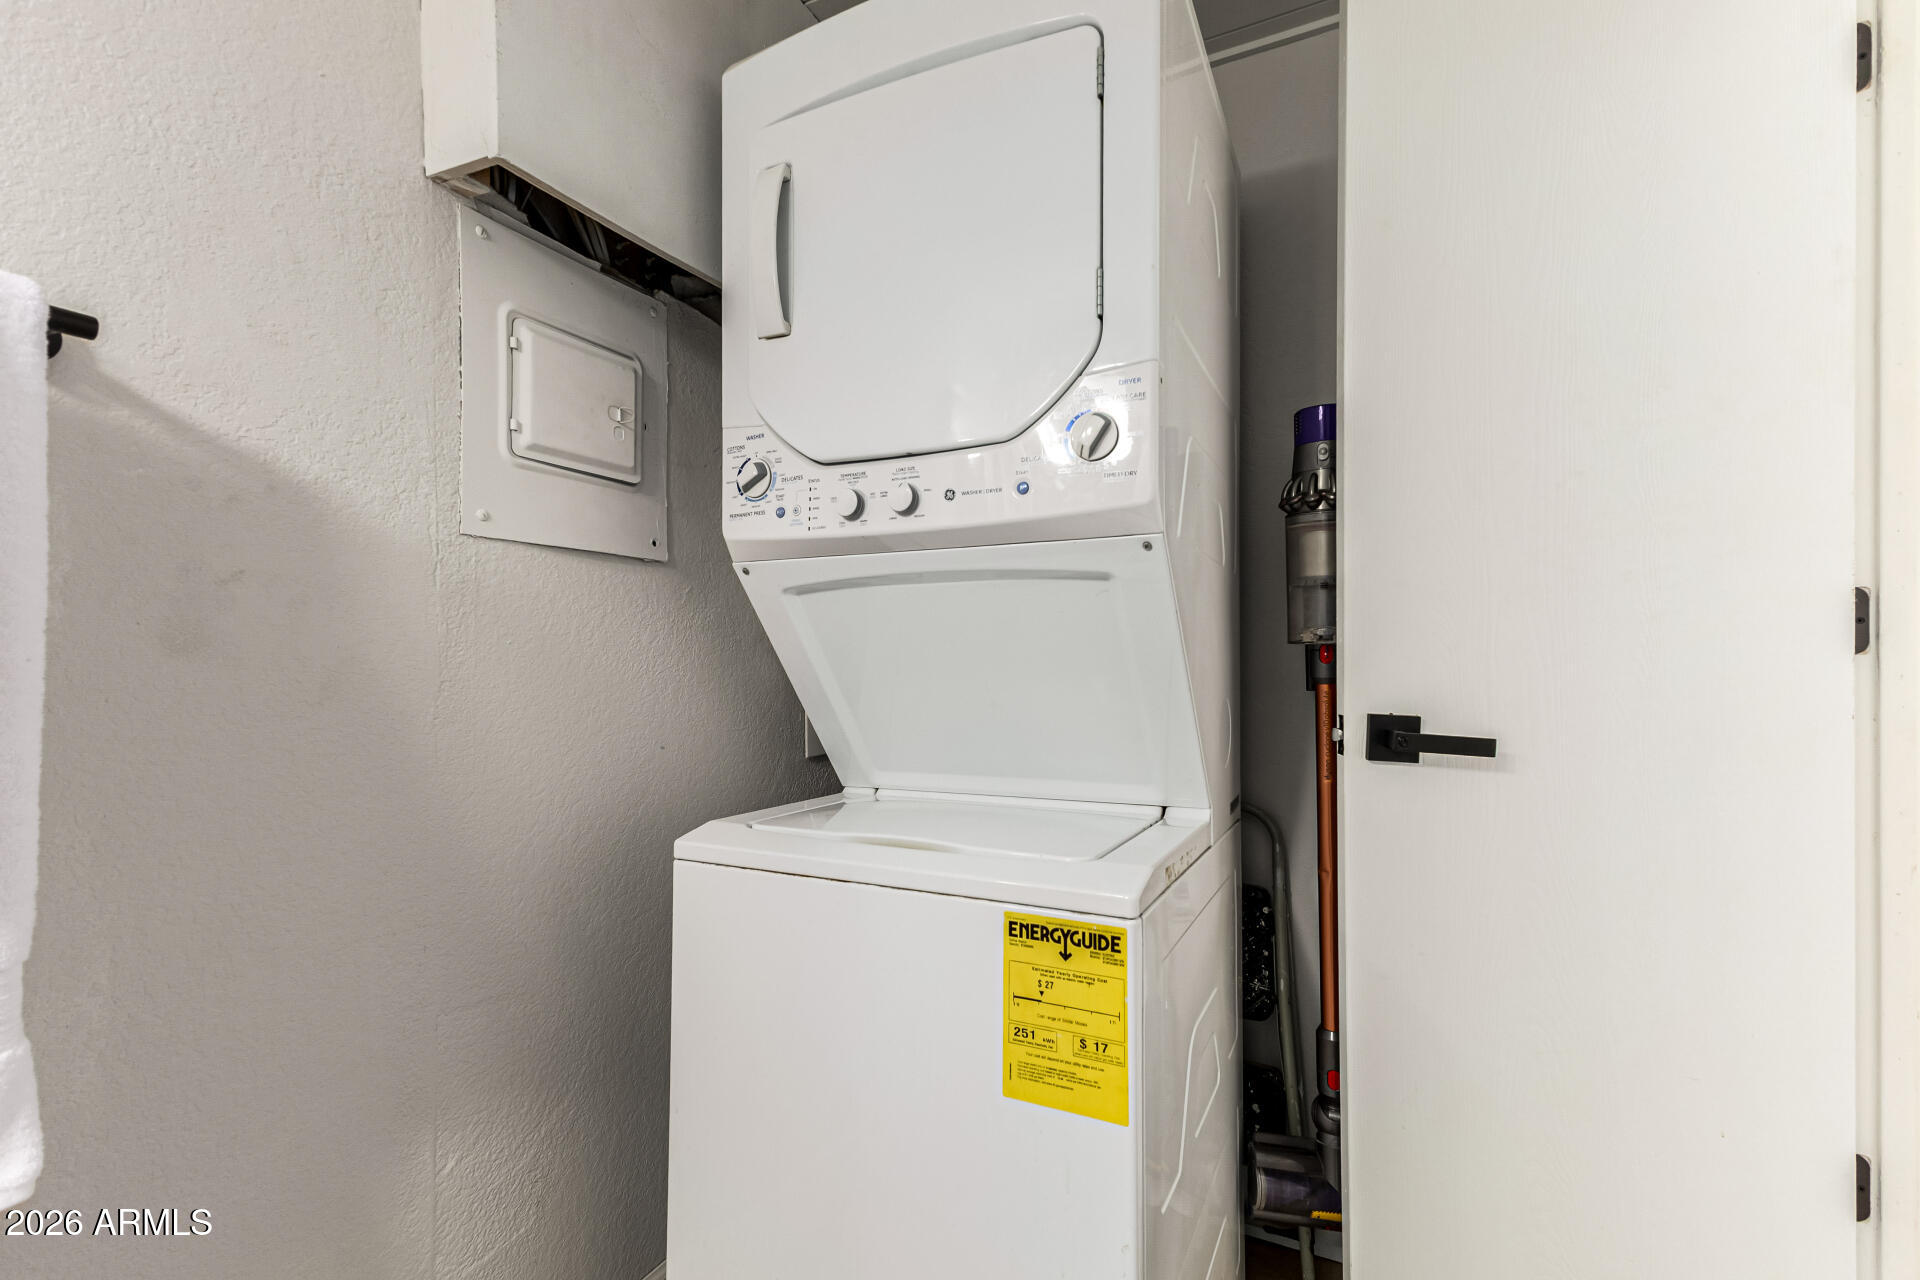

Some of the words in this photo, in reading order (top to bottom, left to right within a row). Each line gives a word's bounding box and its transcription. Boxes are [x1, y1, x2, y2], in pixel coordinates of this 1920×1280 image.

[746, 433, 765, 441] WASHER
[781, 474, 804, 484] DELICATES
[960, 488, 983, 496] WASHER
[1008, 920, 1122, 954] ENERGYGUIDE
[1037, 979, 1043, 988] $
[1044, 980, 1054, 990] 27
[1013, 1026, 1035, 1040] 251
[1042, 1037, 1056, 1045] kWh
[1079, 1038, 1087, 1050] $
[1094, 1041, 1109, 1054] 17
